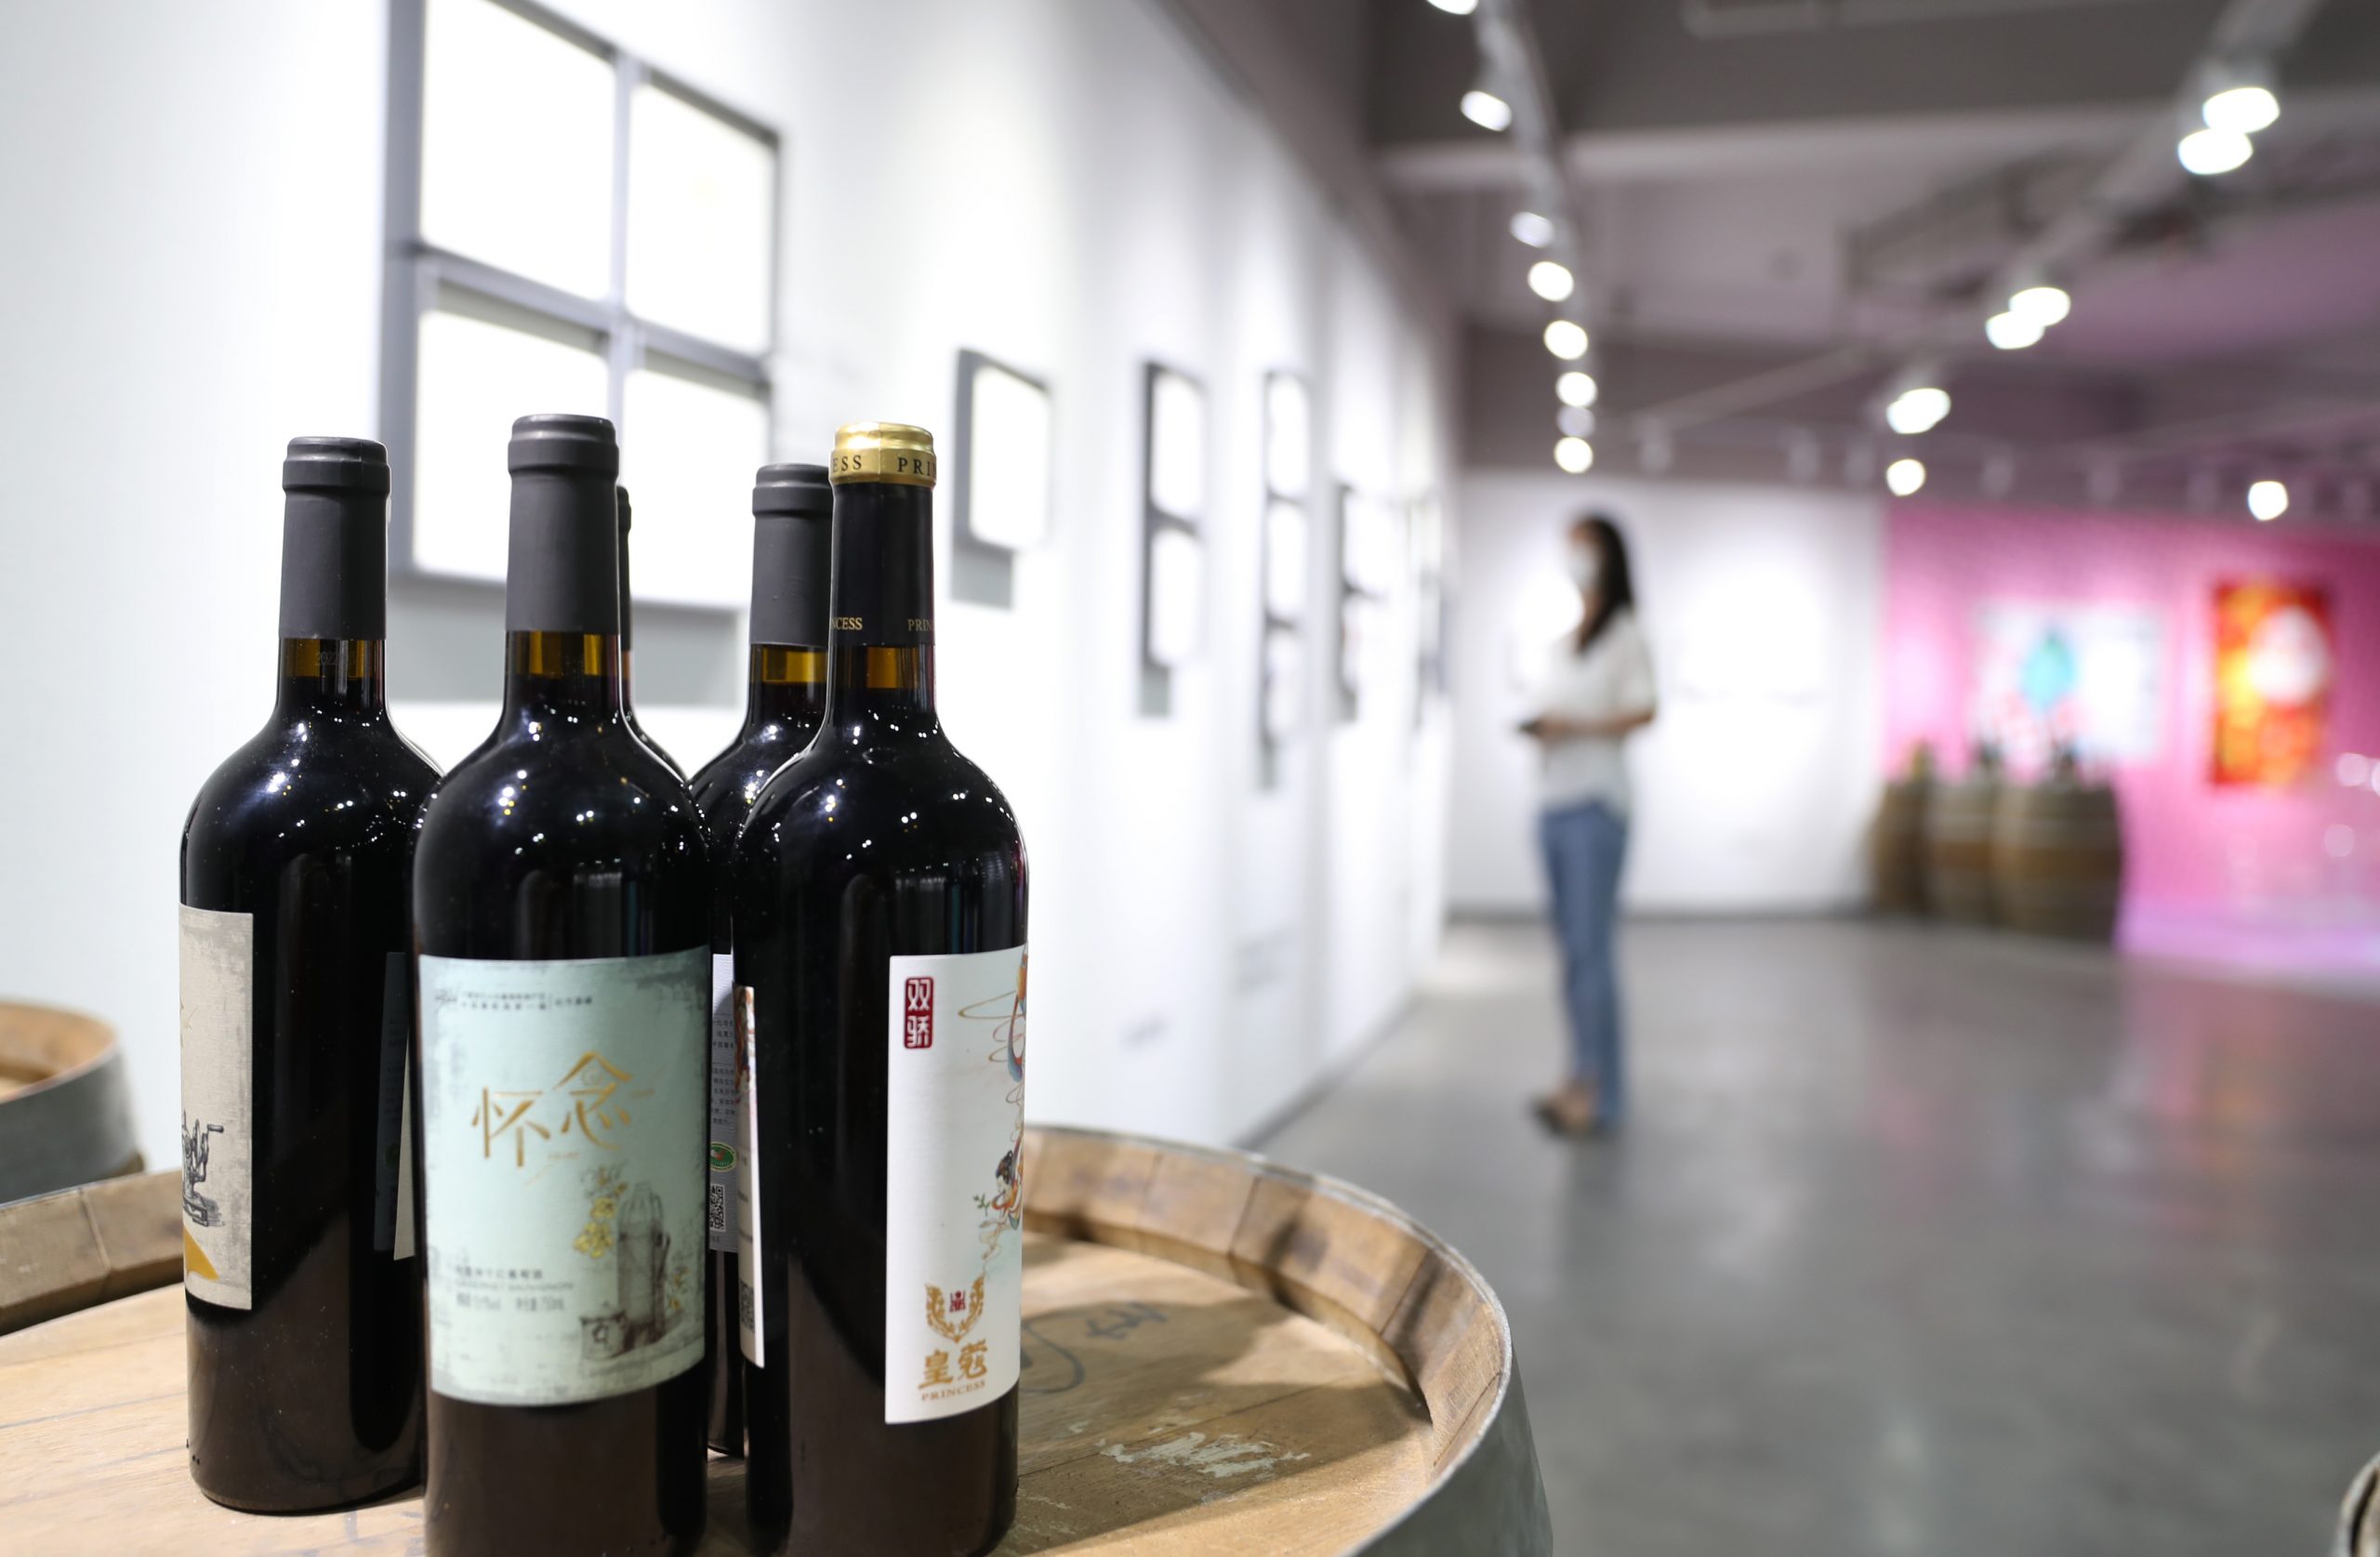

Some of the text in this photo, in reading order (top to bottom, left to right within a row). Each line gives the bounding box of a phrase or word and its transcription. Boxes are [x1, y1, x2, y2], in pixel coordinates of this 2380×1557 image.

[906, 978, 931, 1048] 双骄
[471, 1050, 633, 1168] 怀念
[921, 1379, 985, 1401] PRINCESS
